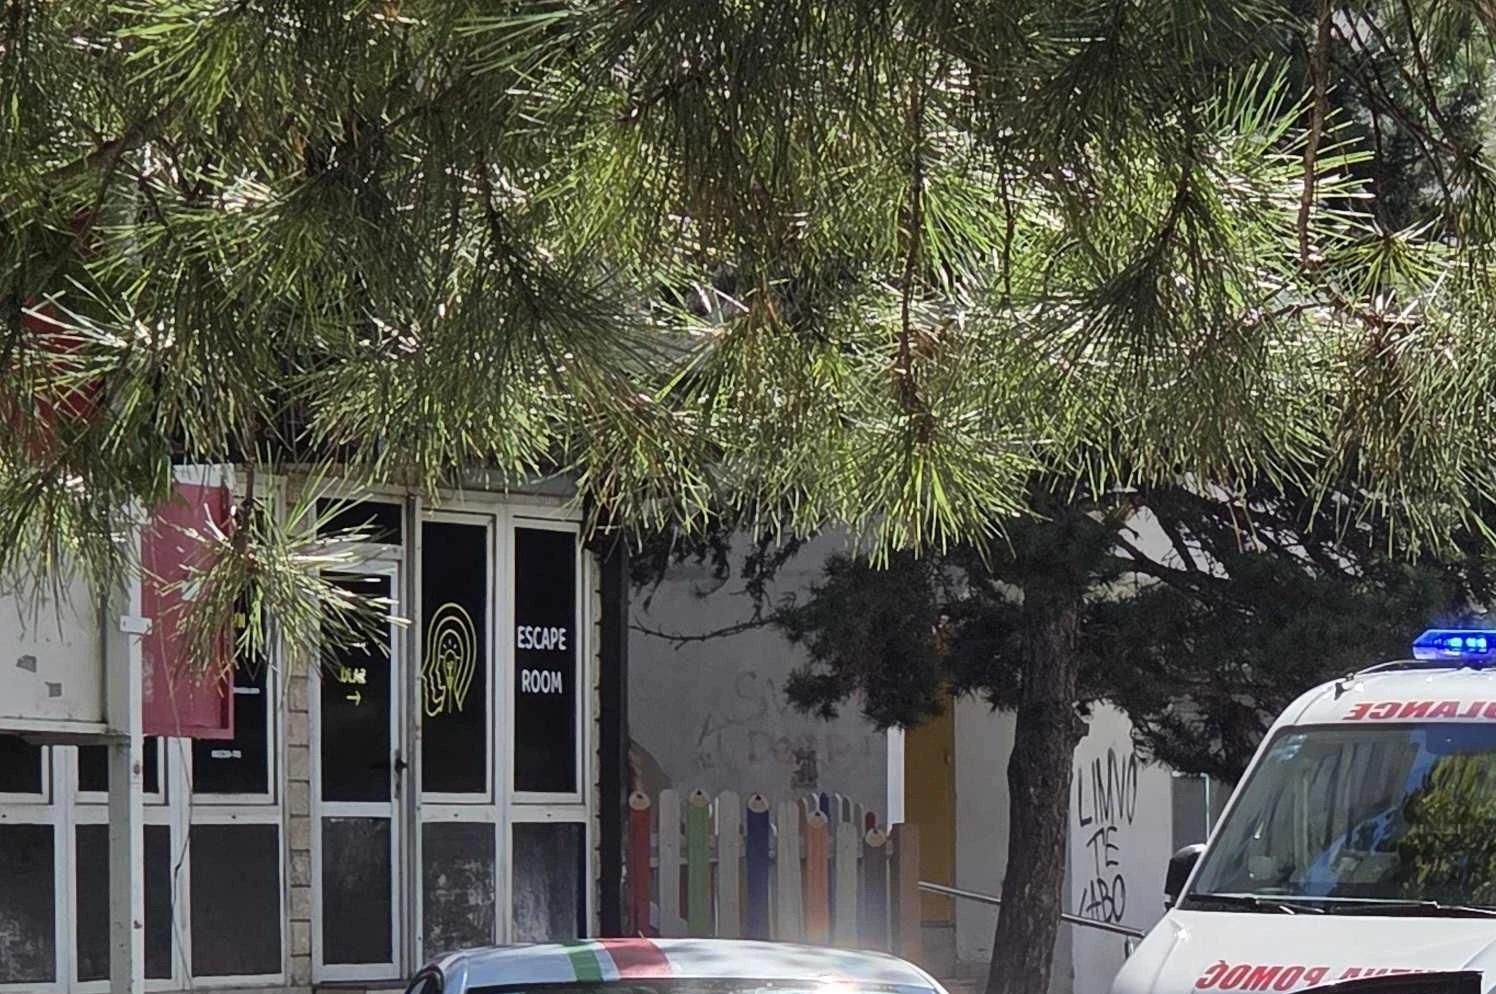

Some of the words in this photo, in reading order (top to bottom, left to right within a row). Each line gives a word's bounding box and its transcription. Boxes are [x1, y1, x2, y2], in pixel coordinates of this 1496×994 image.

[516, 625, 568, 651] ESCAPE
[521, 668, 563, 694] ROOM
[1086, 825, 1120, 877] TE
